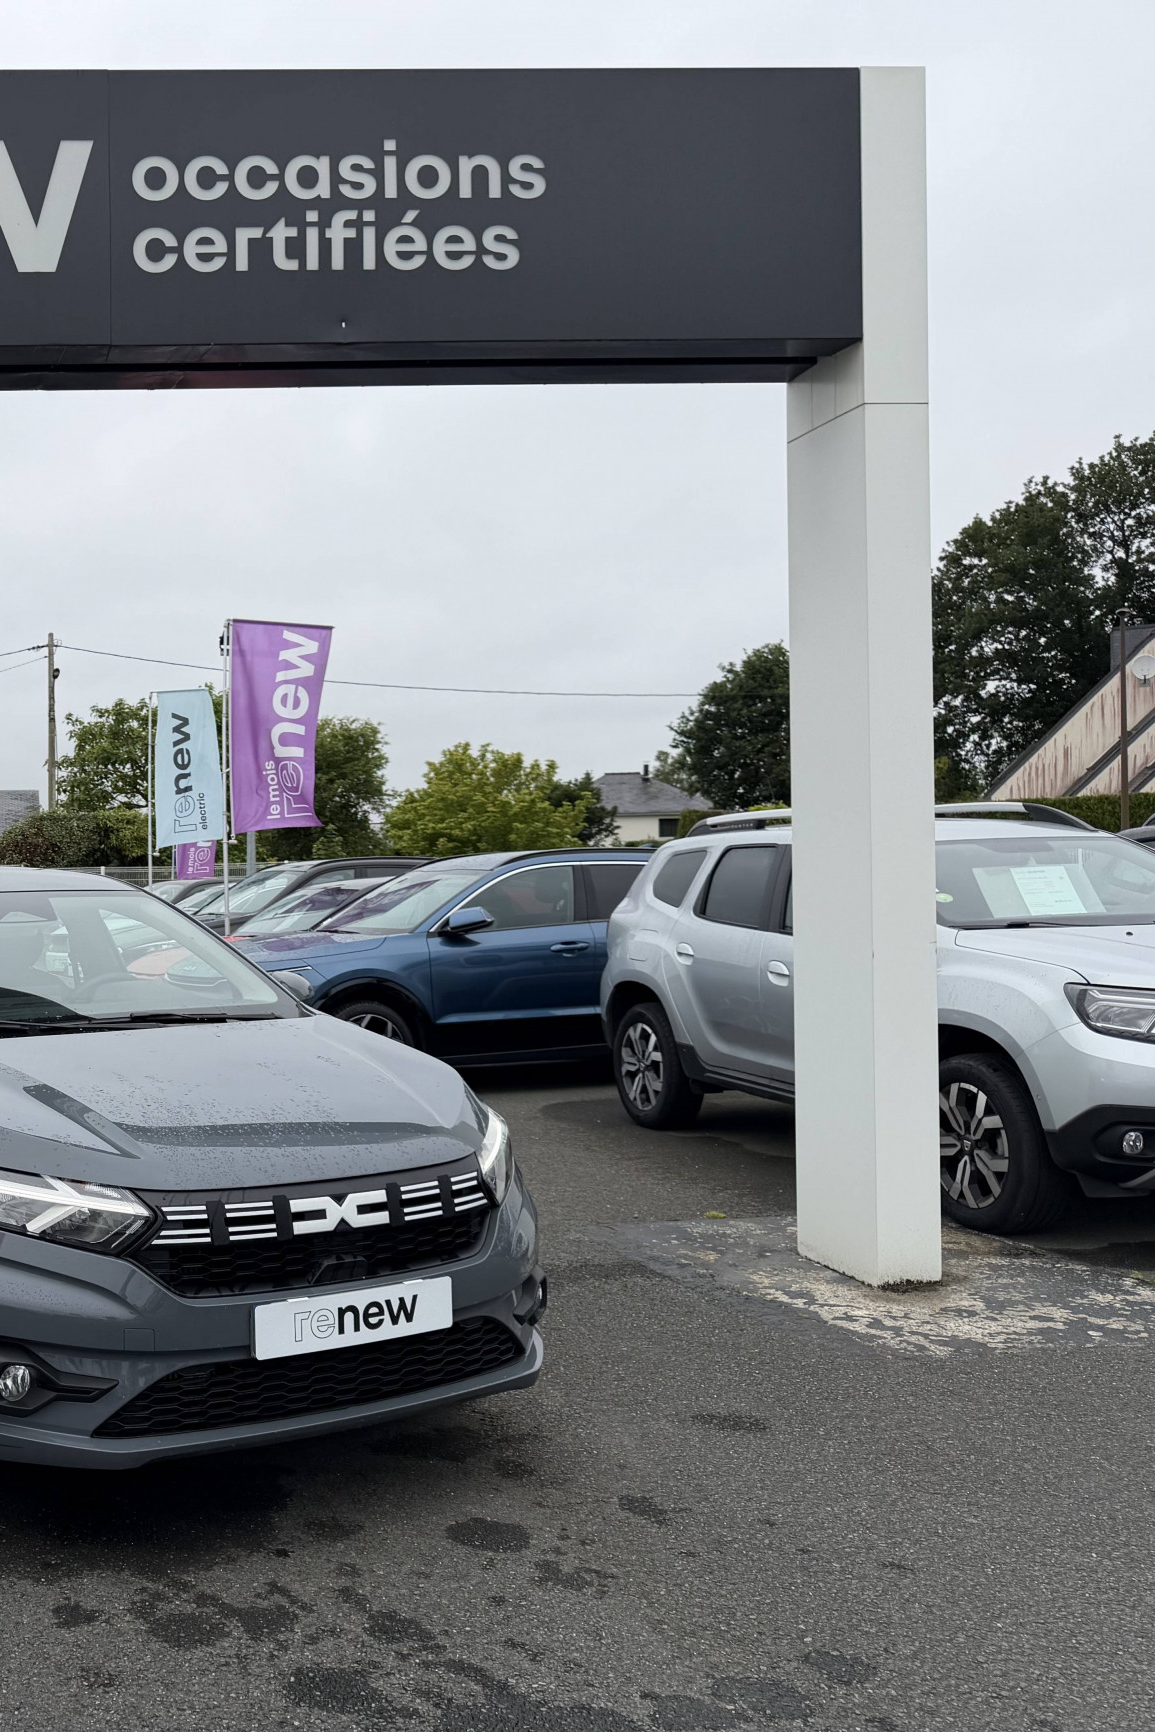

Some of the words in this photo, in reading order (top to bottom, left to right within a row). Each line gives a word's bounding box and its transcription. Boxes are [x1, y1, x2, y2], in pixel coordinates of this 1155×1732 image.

[131, 138, 546, 201] occasions
[133, 209, 520, 273] certifiées
[270, 629, 319, 818] renew
[171, 712, 197, 833] renew
[263, 761, 281, 802] mois
[197, 792, 207, 830] electric
[266, 804, 280, 819] le
[294, 1293, 419, 1342] renew
